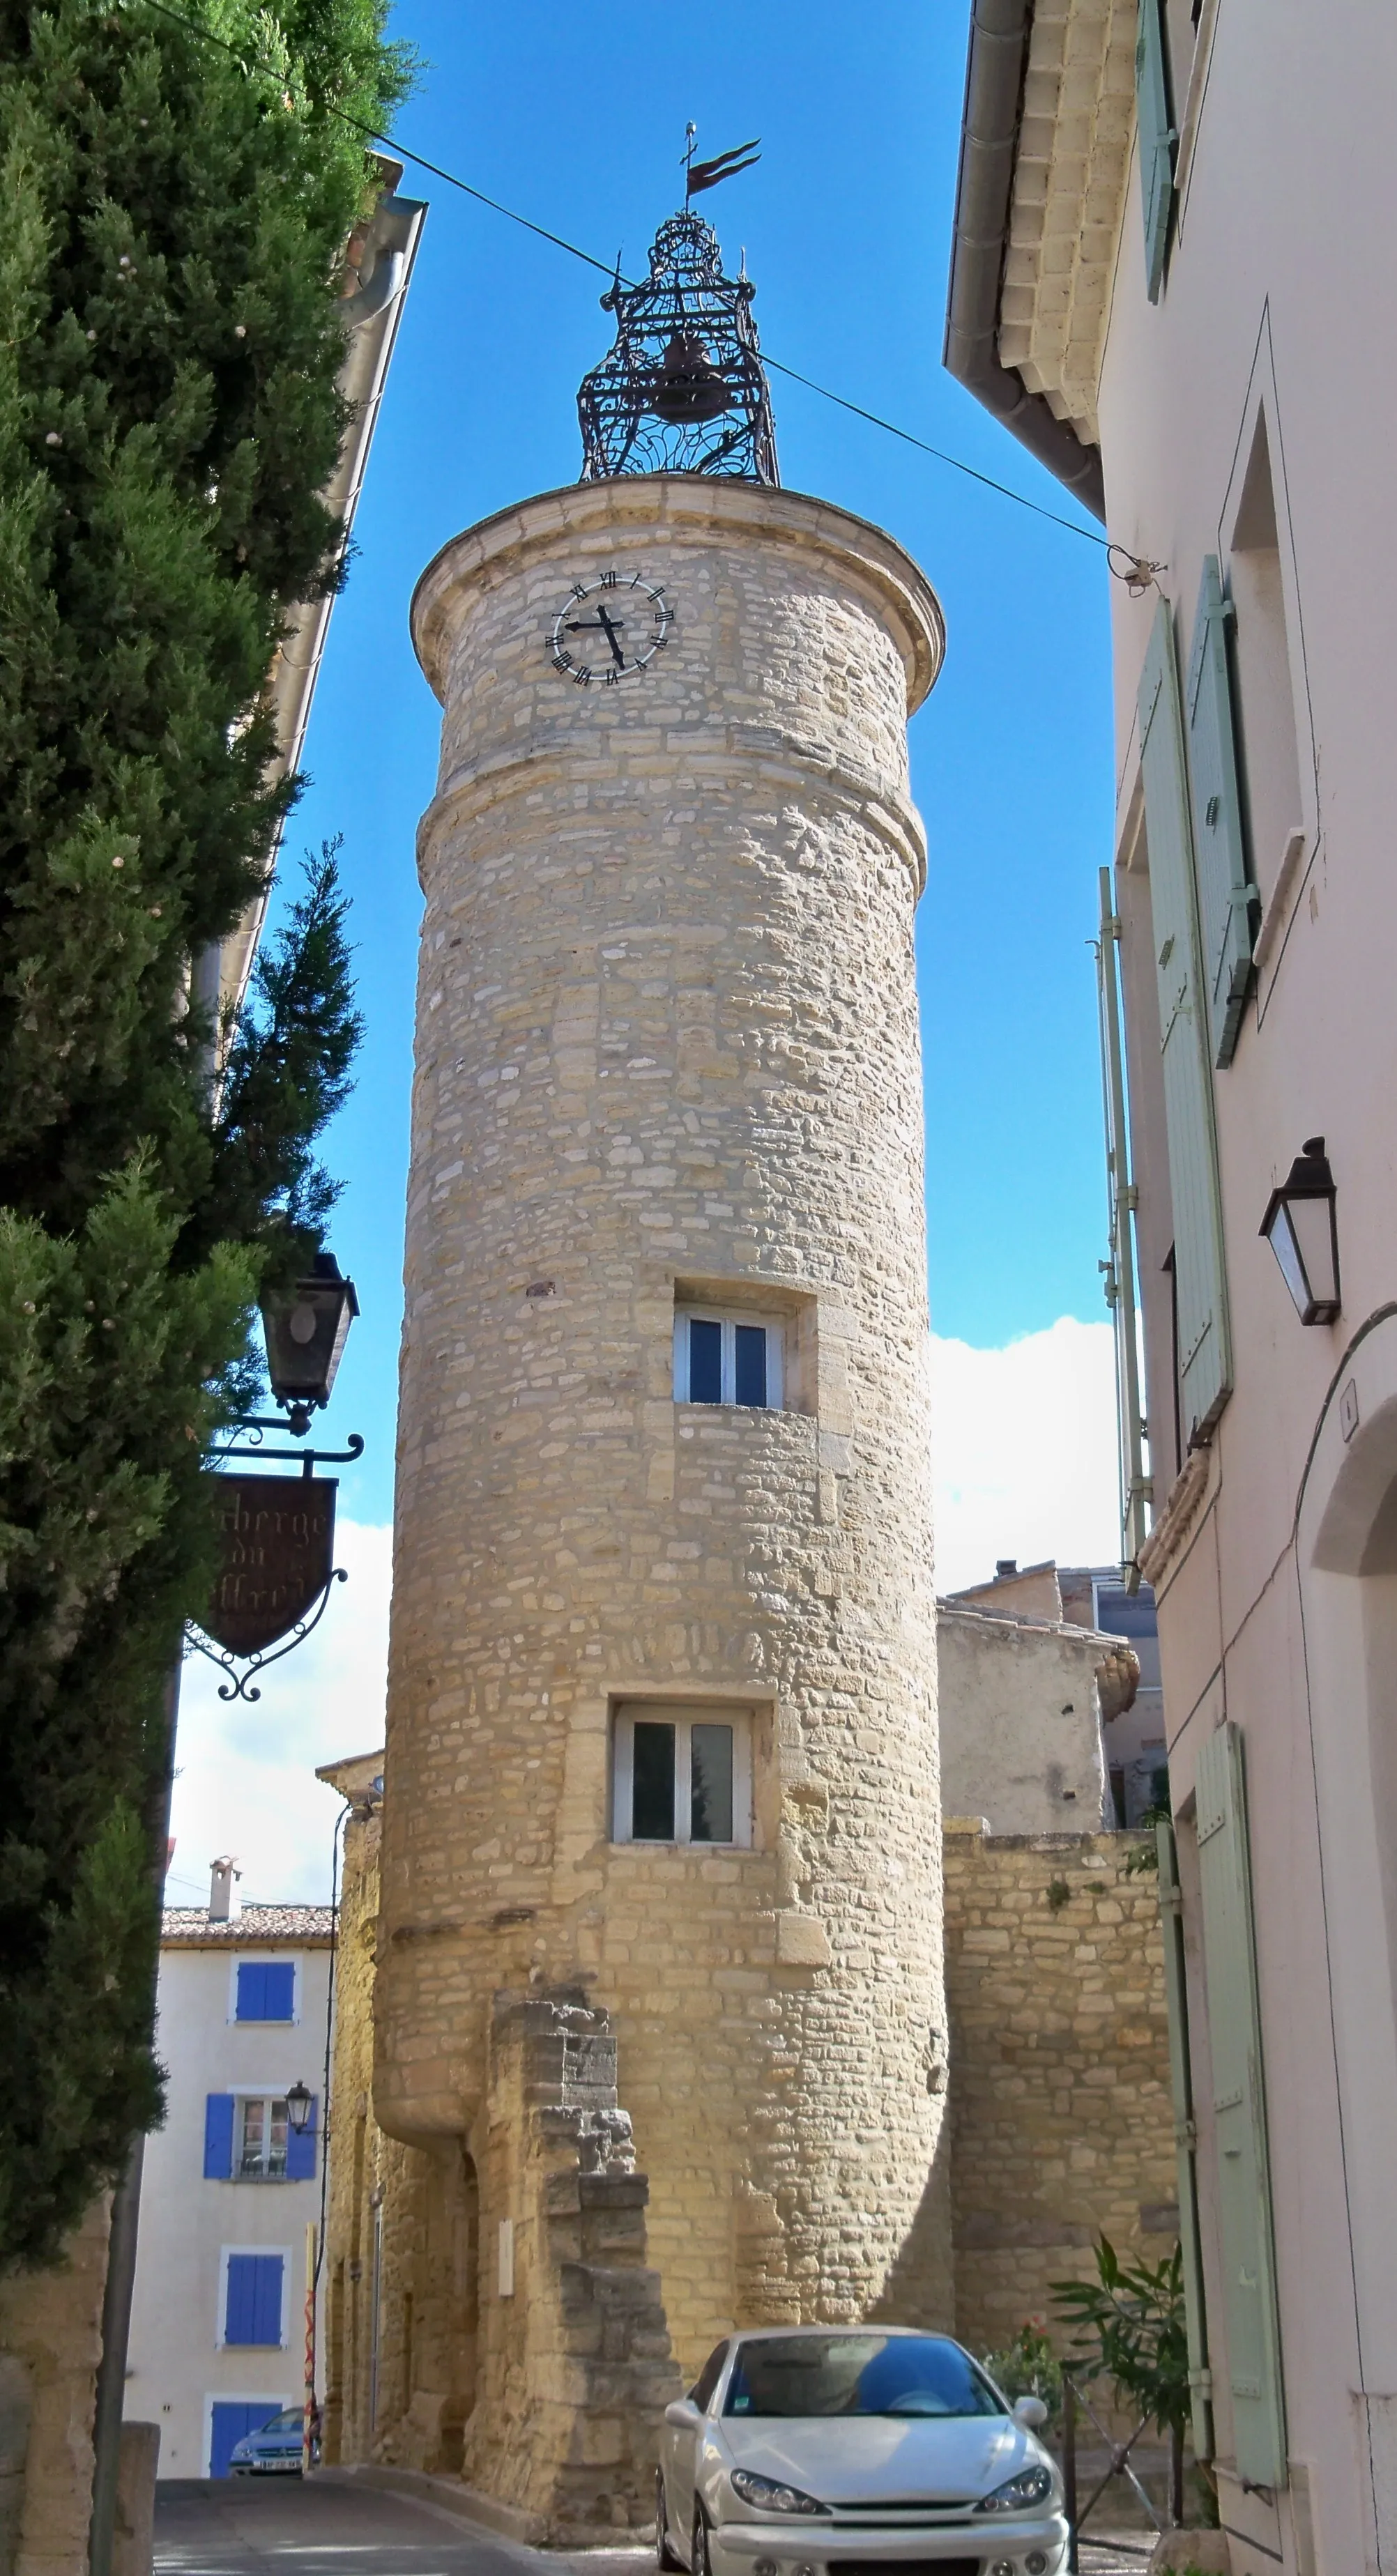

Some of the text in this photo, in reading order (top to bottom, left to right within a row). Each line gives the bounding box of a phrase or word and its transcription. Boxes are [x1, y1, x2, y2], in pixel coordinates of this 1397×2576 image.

[600, 571, 616, 590] XII
[629, 573, 641, 590] I
[570, 584, 588, 603] XI
[647, 586, 666, 603] II
[655, 610, 675, 623] III
[545, 633, 565, 648] IX
[551, 650, 574, 675] VIII
[634, 657, 648, 672] V
[572, 666, 592, 687] VII
